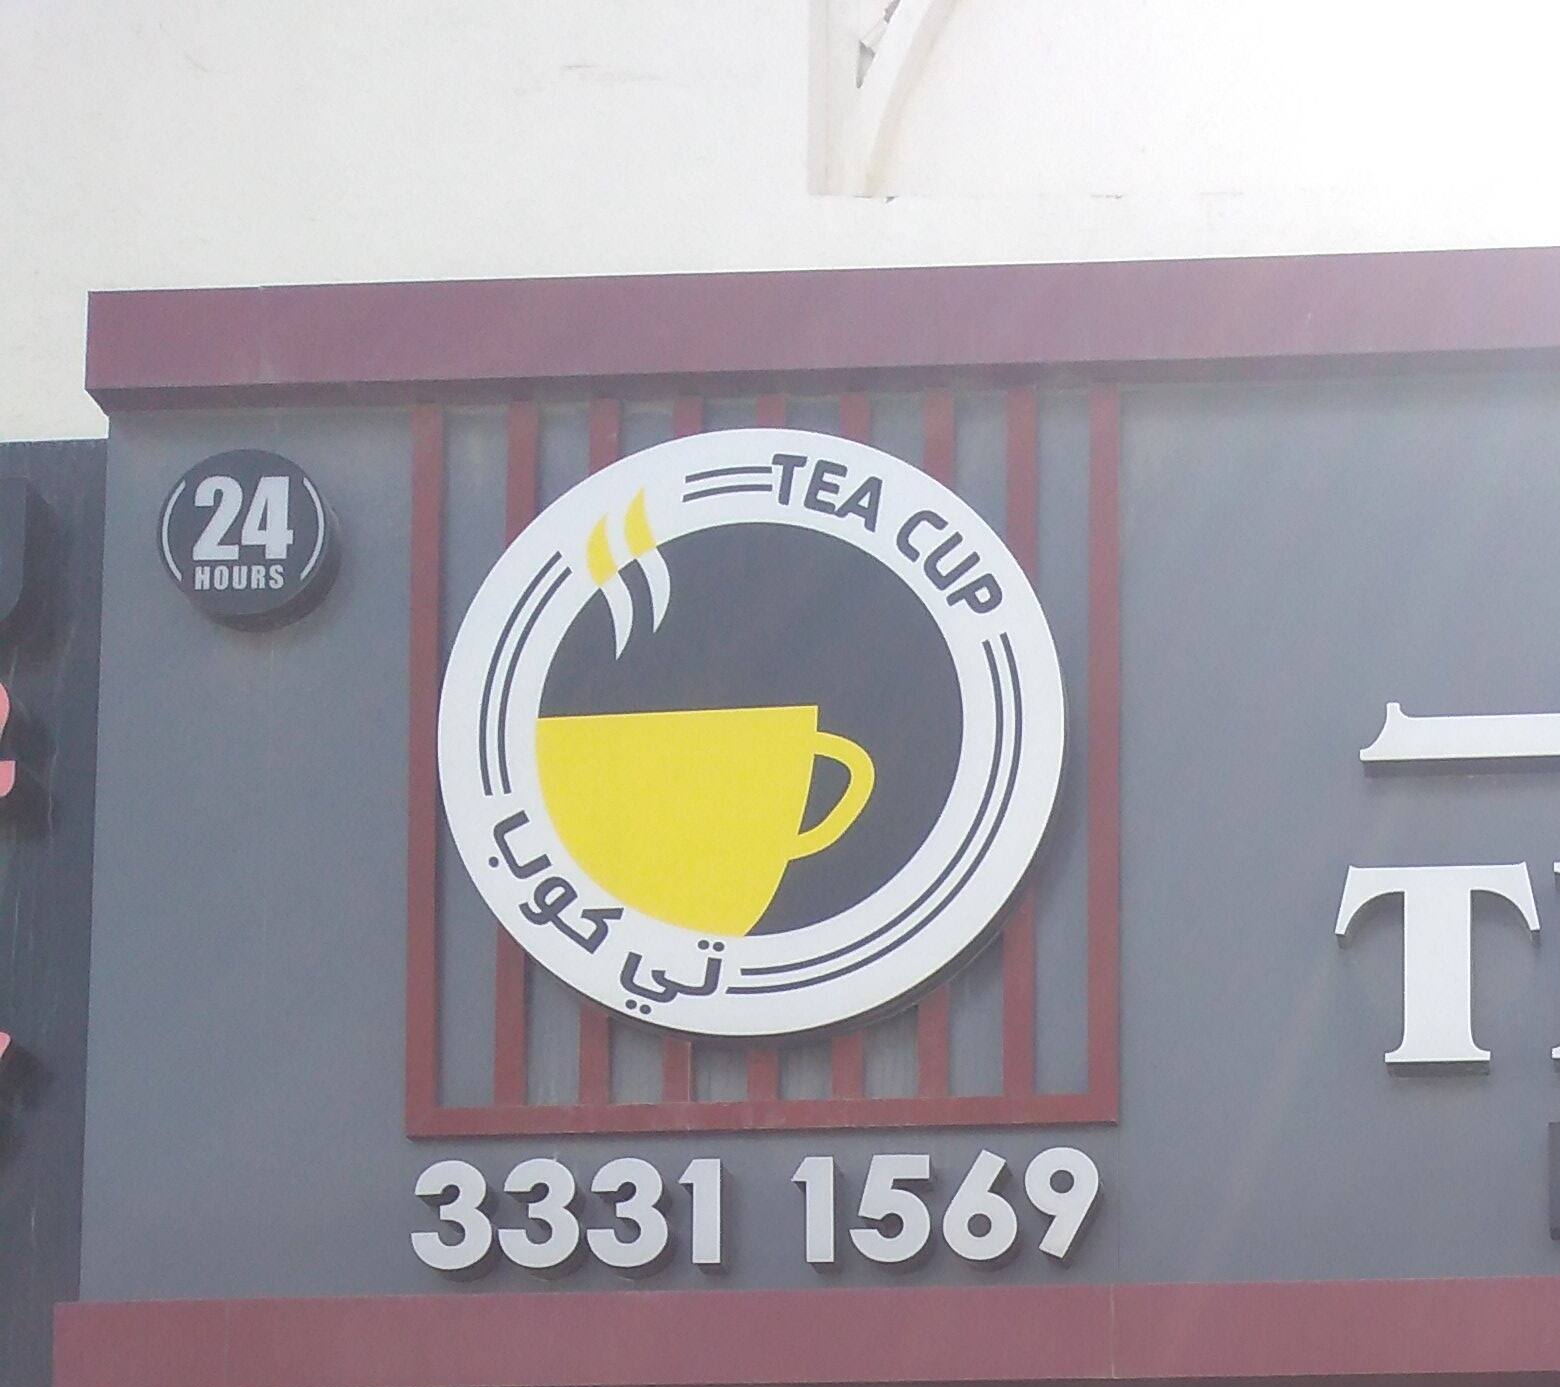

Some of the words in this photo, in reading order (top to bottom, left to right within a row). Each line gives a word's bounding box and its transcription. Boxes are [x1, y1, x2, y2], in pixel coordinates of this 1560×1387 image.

[192, 475, 294, 561] 24
[771, 453, 884, 533] TEA
[896, 510, 1003, 614] CUP
[194, 565, 284, 590] HOURS
[488, 809, 624, 955] كوب
[619, 939, 725, 1015] تي
[410, 1157, 722, 1270] 3331
[790, 1146, 1099, 1263] 1569
